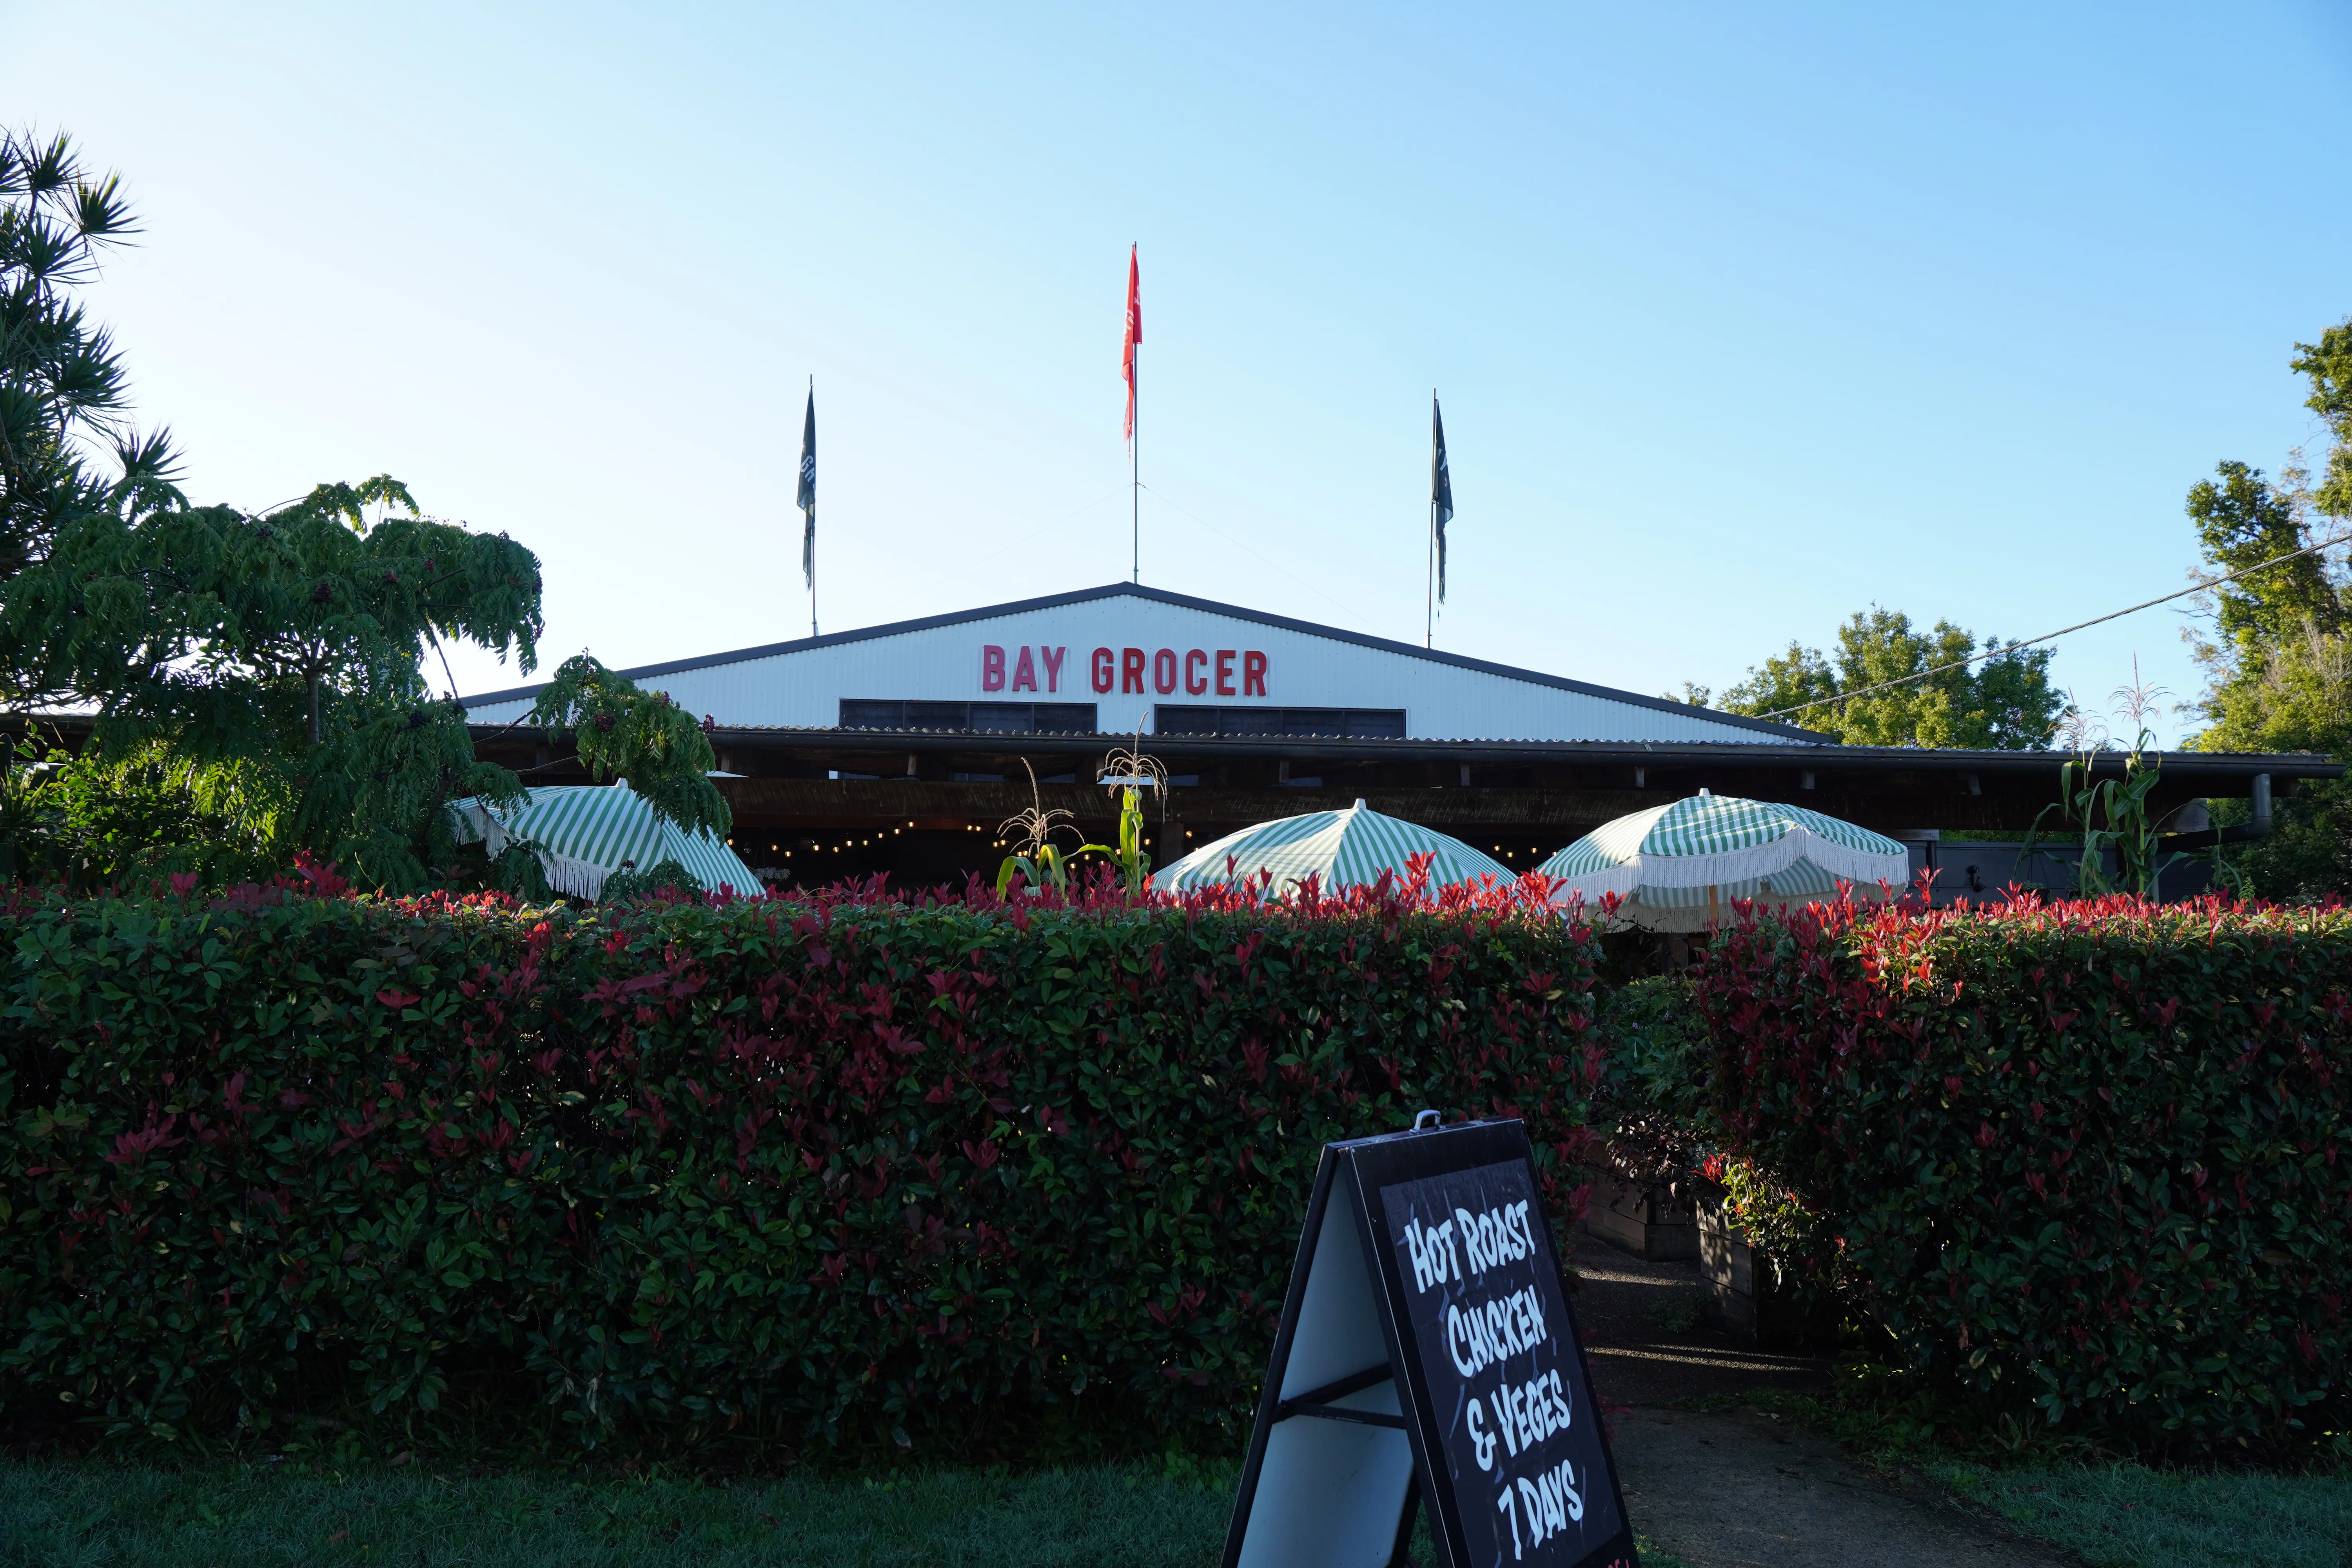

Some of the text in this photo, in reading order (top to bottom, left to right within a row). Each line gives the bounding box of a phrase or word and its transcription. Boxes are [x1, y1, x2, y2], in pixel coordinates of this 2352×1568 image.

[983, 645, 1267, 696] BAY GROCER
[1404, 1199, 1535, 1294] HOT ROAST
[1447, 1285, 1546, 1378] CHICKEN
[1467, 1369, 1571, 1471] & VEGES
[1497, 1459, 1583, 1560] 7 DAYS
